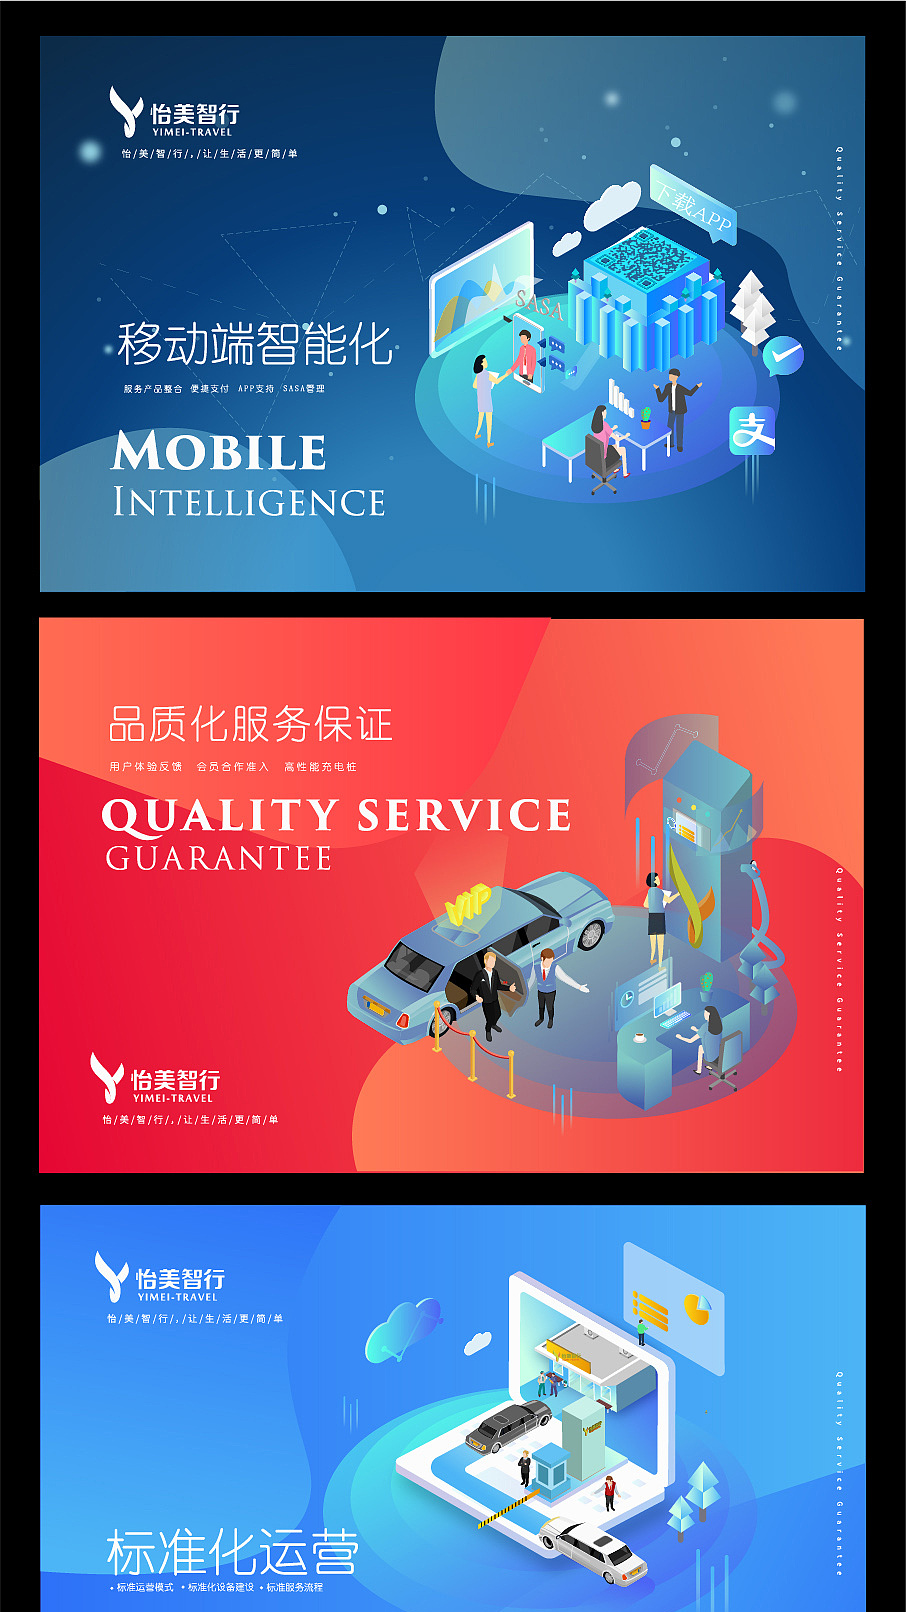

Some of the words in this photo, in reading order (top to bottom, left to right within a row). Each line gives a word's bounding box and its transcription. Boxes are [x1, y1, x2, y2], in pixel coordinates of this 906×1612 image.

[150, 103, 240, 125] 怡美智行
[152, 128, 232, 137] YIMEI-TRAVEL
[836, 147, 844, 200] Quality
[655, 180, 732, 232] 下载APP
[836, 212, 844, 265] Service
[515, 290, 564, 322] SASA
[836, 277, 844, 350] Guarantee
[118, 321, 393, 366] 移动端智能化
[124, 384, 183, 394] 服务产品整合
[190, 384, 229, 394] 便捷支付
[238, 384, 274, 394] APP支持
[283, 384, 325, 394] SASA管理
[109, 705, 393, 742] 品质化服务保证
[109, 761, 183, 773] 用户体验反馈
[196, 761, 269, 773] 会员合作准入
[284, 761, 357, 773] 高性能充电桩
[101, 798, 340, 840] QUALITY
[358, 798, 571, 832] SERVICE
[106, 845, 331, 871] GUARANTEE
[445, 883, 492, 927] VIP
[835, 868, 844, 921] Quality
[836, 933, 844, 986] Service
[836, 998, 844, 1071] Guarantee
[131, 1069, 220, 1091] 怡美智行
[133, 1094, 213, 1103] YIMEI-TRAVEL
[136, 1268, 225, 1290] 怡美智行
[137, 1293, 217, 1302] YIMEI-TRAVEL
[836, 1372, 844, 1425] Quality
[836, 1437, 844, 1490] Service
[106, 1528, 358, 1576] 标准化运营
[836, 1502, 844, 1575] Guarantee
